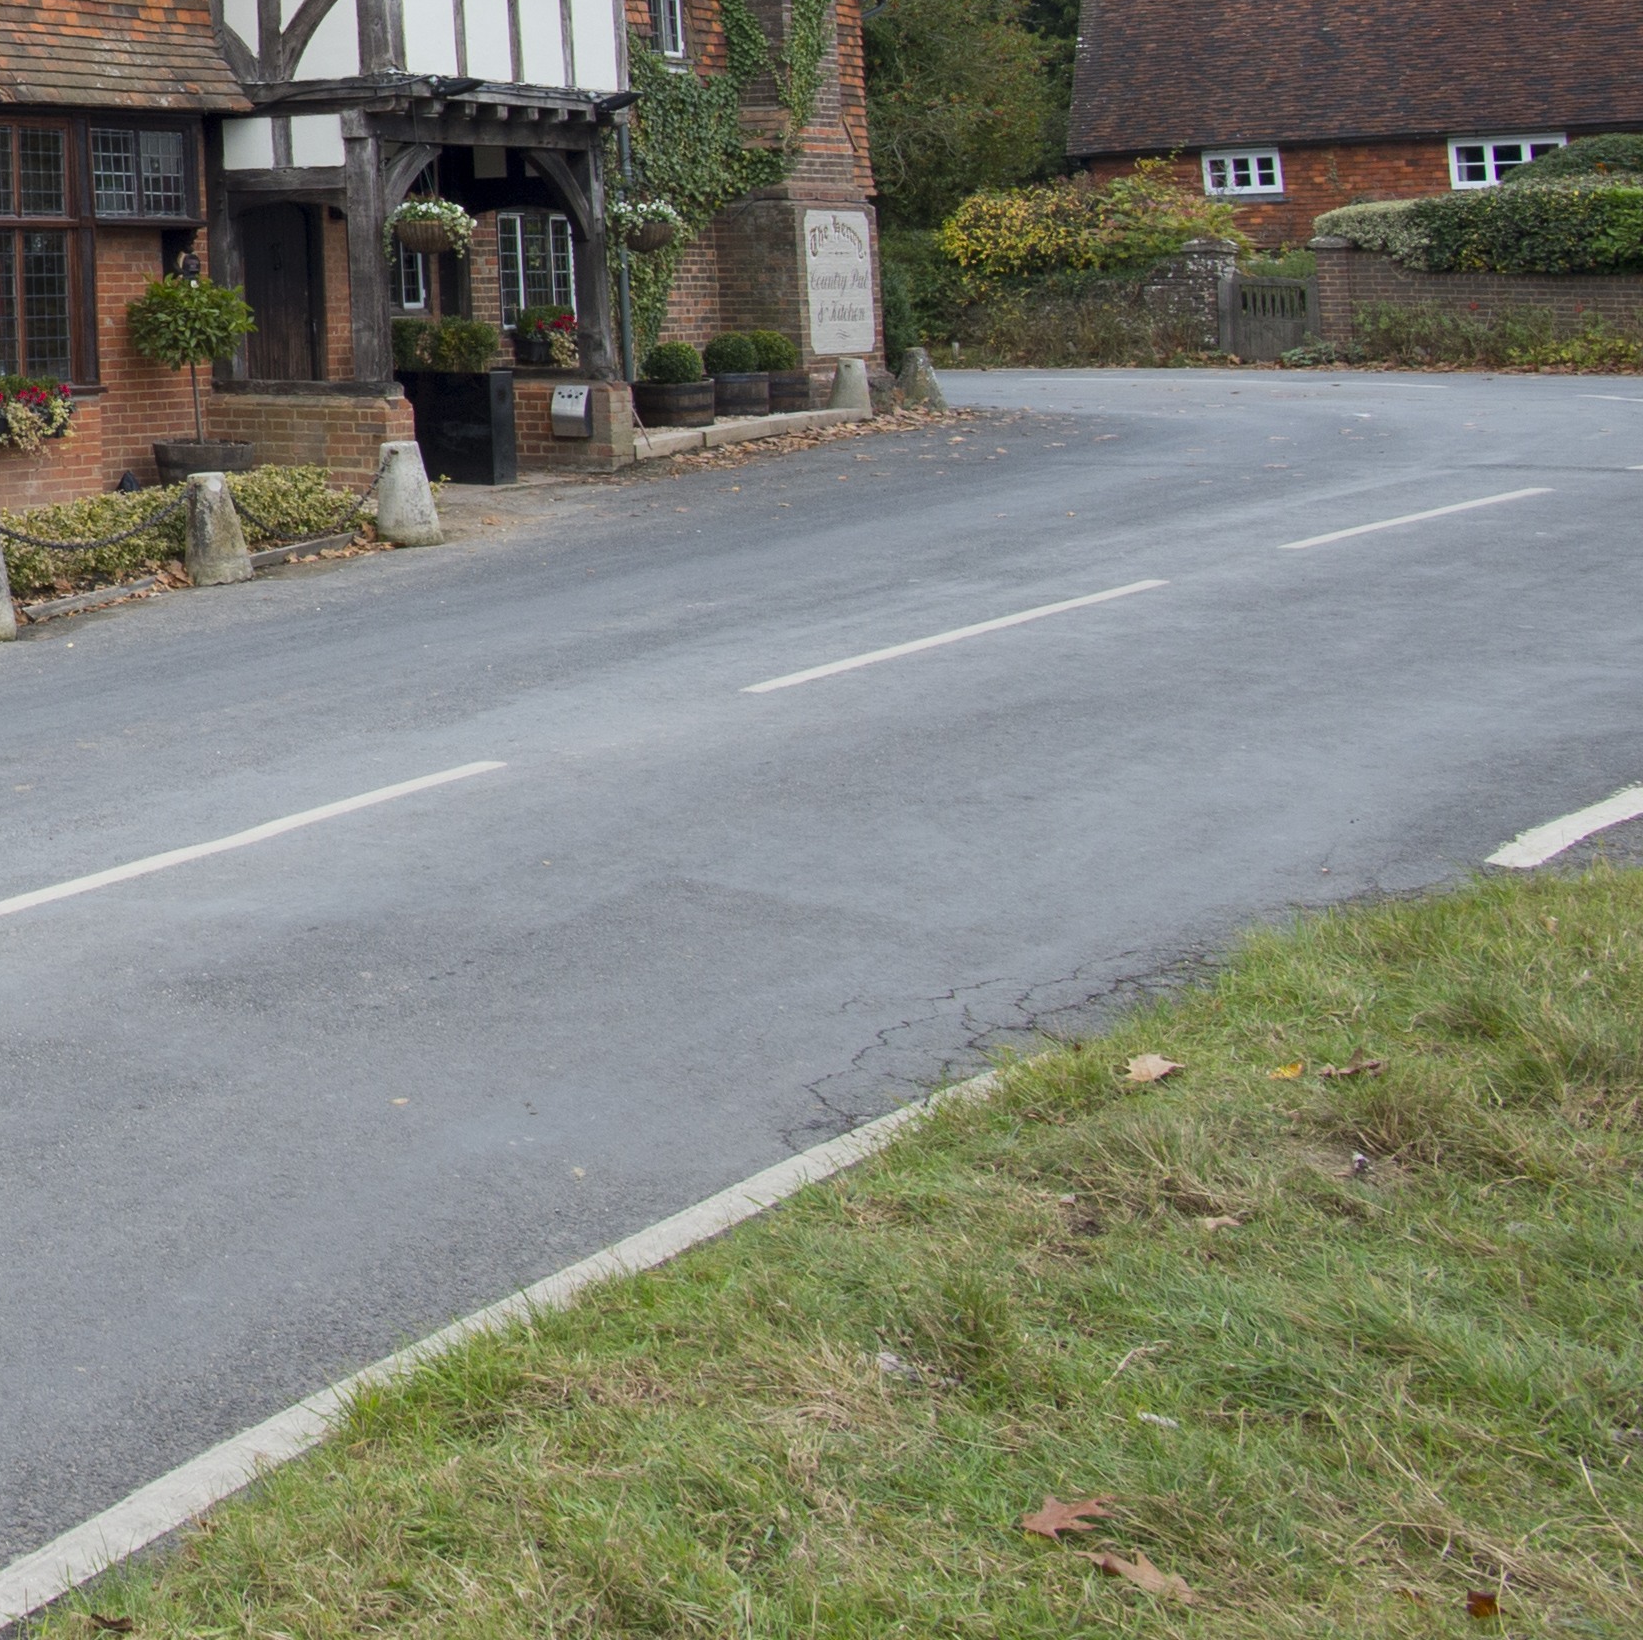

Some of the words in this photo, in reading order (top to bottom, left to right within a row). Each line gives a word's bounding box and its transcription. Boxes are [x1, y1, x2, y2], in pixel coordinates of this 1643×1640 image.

[809, 224, 828, 258] The
[810, 270, 848, 297] Country
[829, 300, 866, 322] Kitchen
